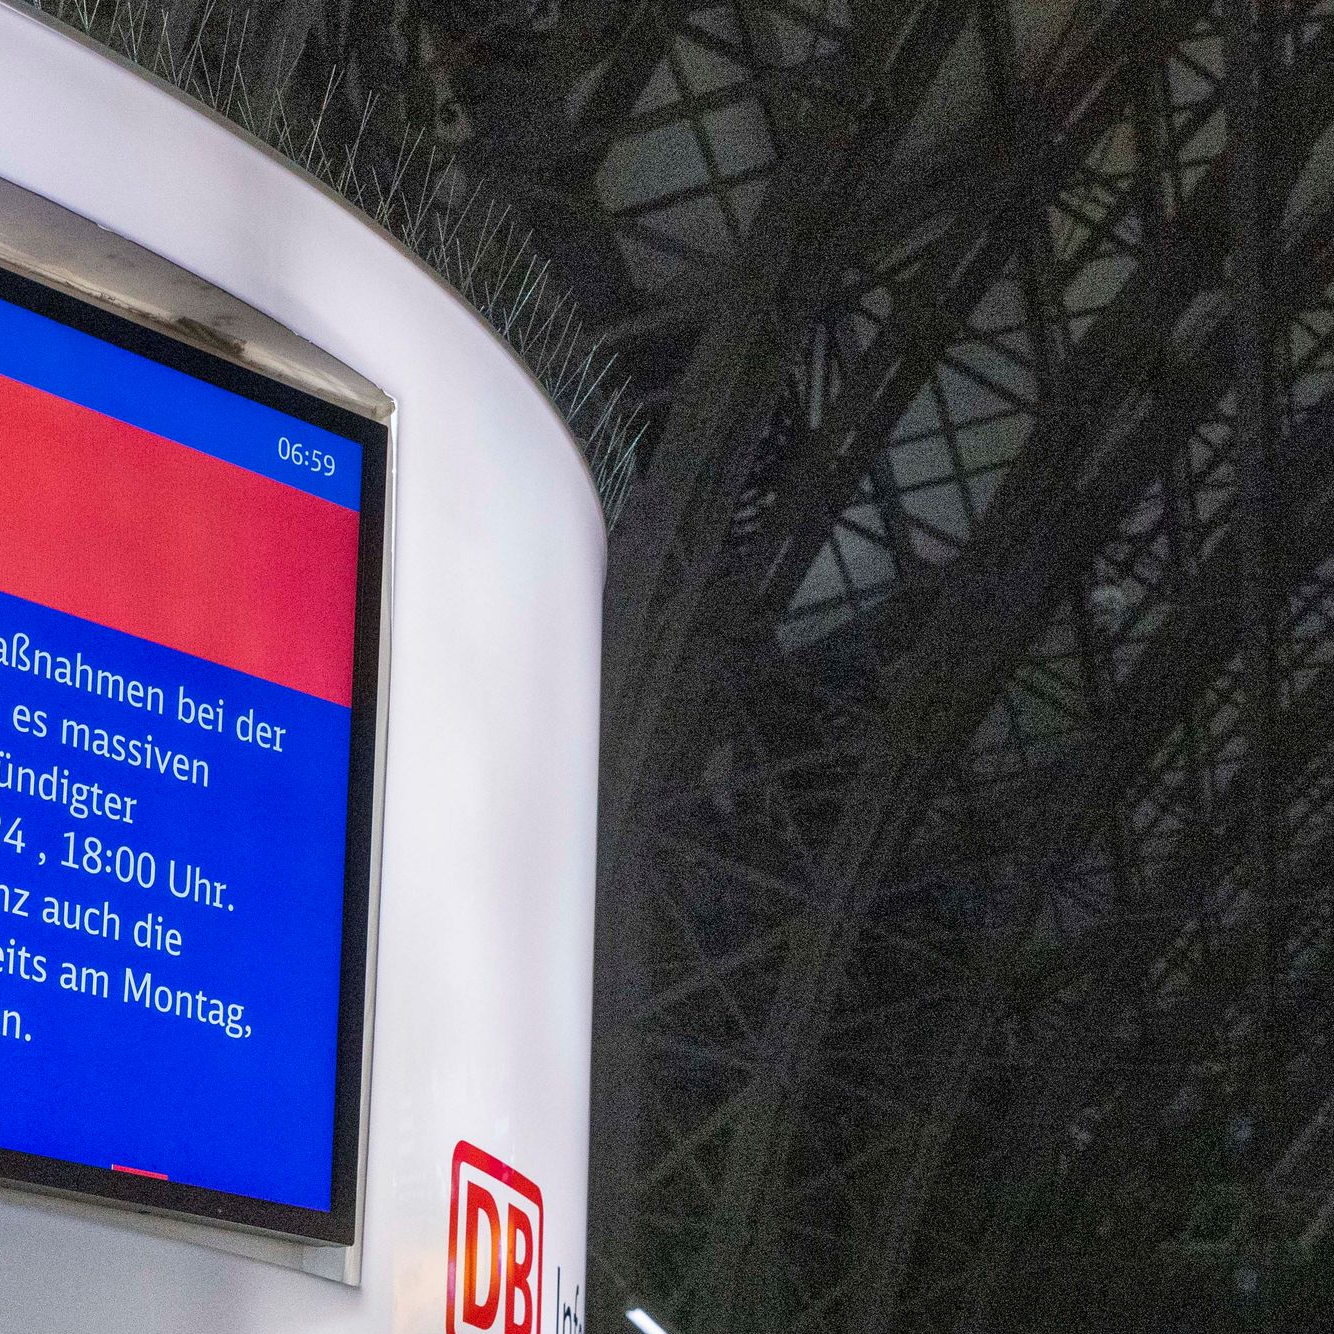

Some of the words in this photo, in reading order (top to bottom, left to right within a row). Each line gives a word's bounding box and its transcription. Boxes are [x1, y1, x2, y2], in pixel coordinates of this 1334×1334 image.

[277, 436, 336, 477] 06:59
[12, 704, 47, 738] es
[61, 719, 209, 787] massiven
[178, 686, 224, 732] bei
[236, 709, 286, 752] der
[61, 831, 156, 889] 18:00
[169, 860, 234, 912] Uhr.
[42, 896, 120, 940] auch
[133, 913, 182, 956] die
[59, 962, 109, 998] am
[123, 967, 252, 1039] Montag,
